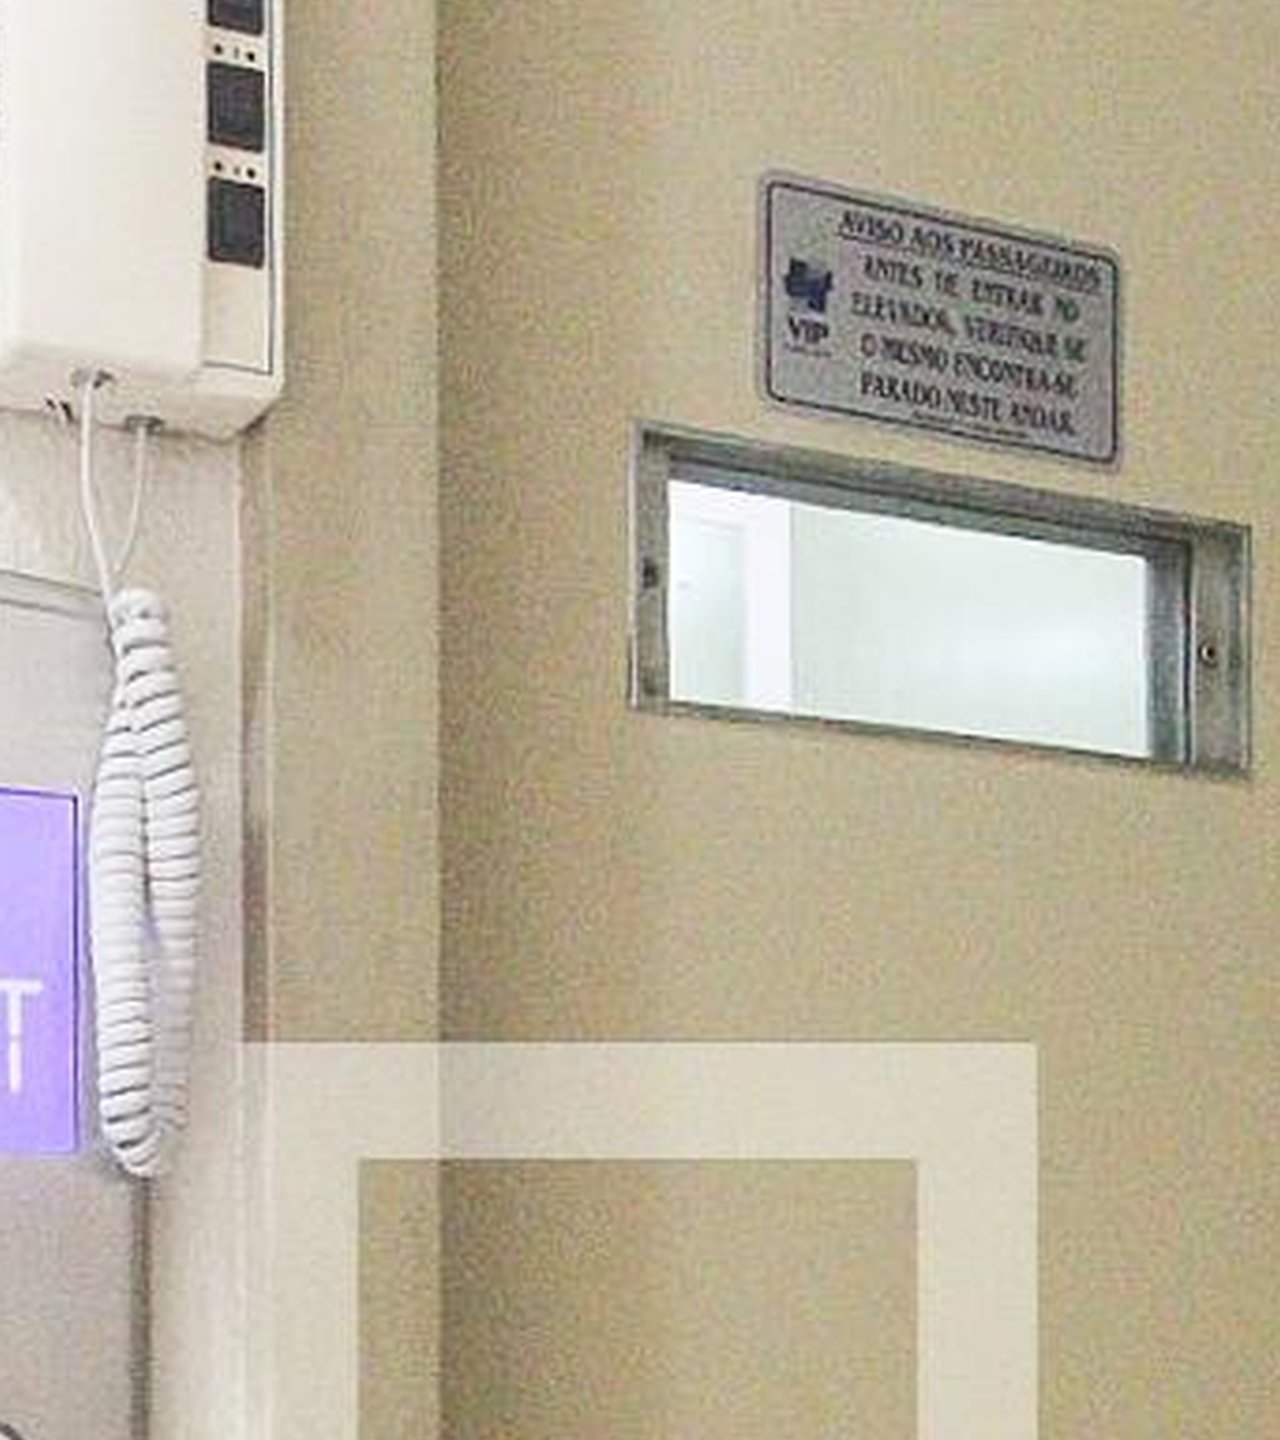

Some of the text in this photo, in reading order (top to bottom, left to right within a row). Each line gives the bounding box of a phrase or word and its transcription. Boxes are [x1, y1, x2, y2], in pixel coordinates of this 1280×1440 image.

[838, 210, 904, 244] AVISO
[910, 226, 954, 256] AOS
[863, 254, 1080, 324] ANTES DE ENTRAR NO
[787, 315, 829, 345] VIP
[860, 332, 878, 359] O
[881, 336, 950, 375] MESMO
[860, 370, 942, 410] PARADO
[947, 386, 1003, 424] NESTE
